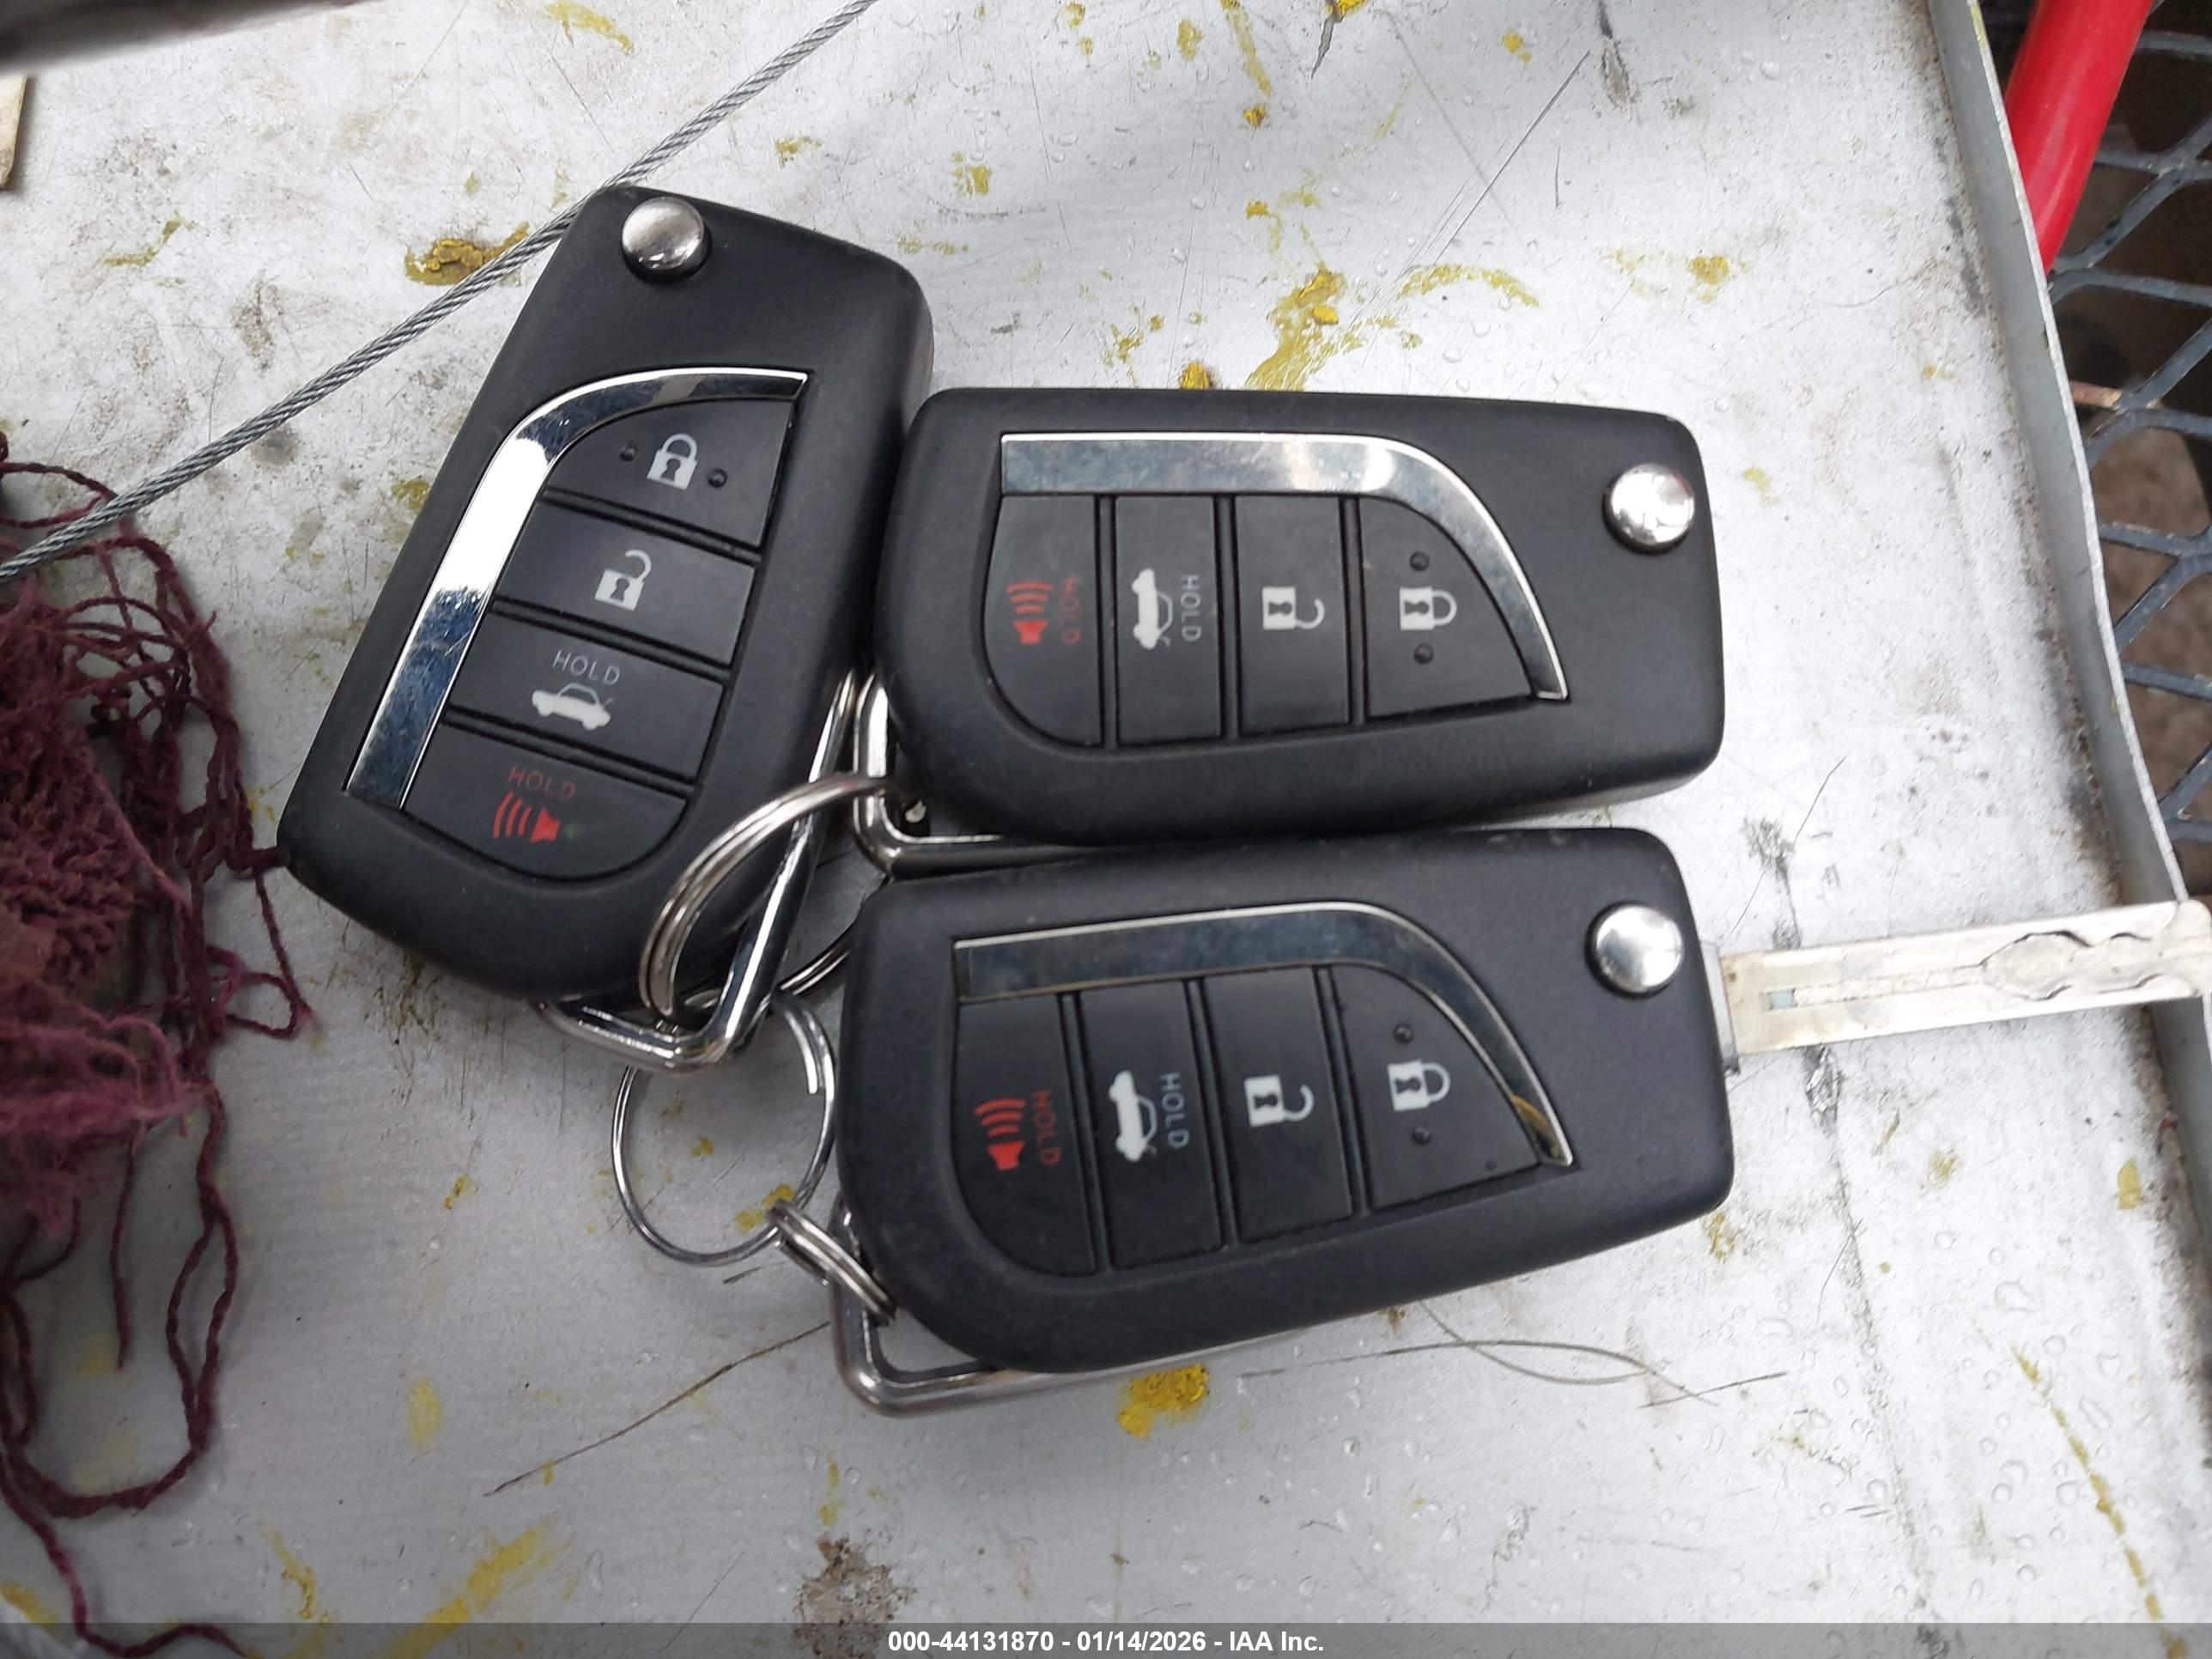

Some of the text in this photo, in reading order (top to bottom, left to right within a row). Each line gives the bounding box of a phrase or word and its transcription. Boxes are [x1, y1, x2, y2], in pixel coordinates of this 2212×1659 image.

[1058, 575, 1082, 646] HOLD
[1181, 574, 1203, 642] HOLD
[551, 649, 621, 686] HOLD
[507, 763, 577, 801] HOLD
[1031, 1088, 1062, 1167] HOLD
[1158, 1072, 1190, 1150] HOLD
